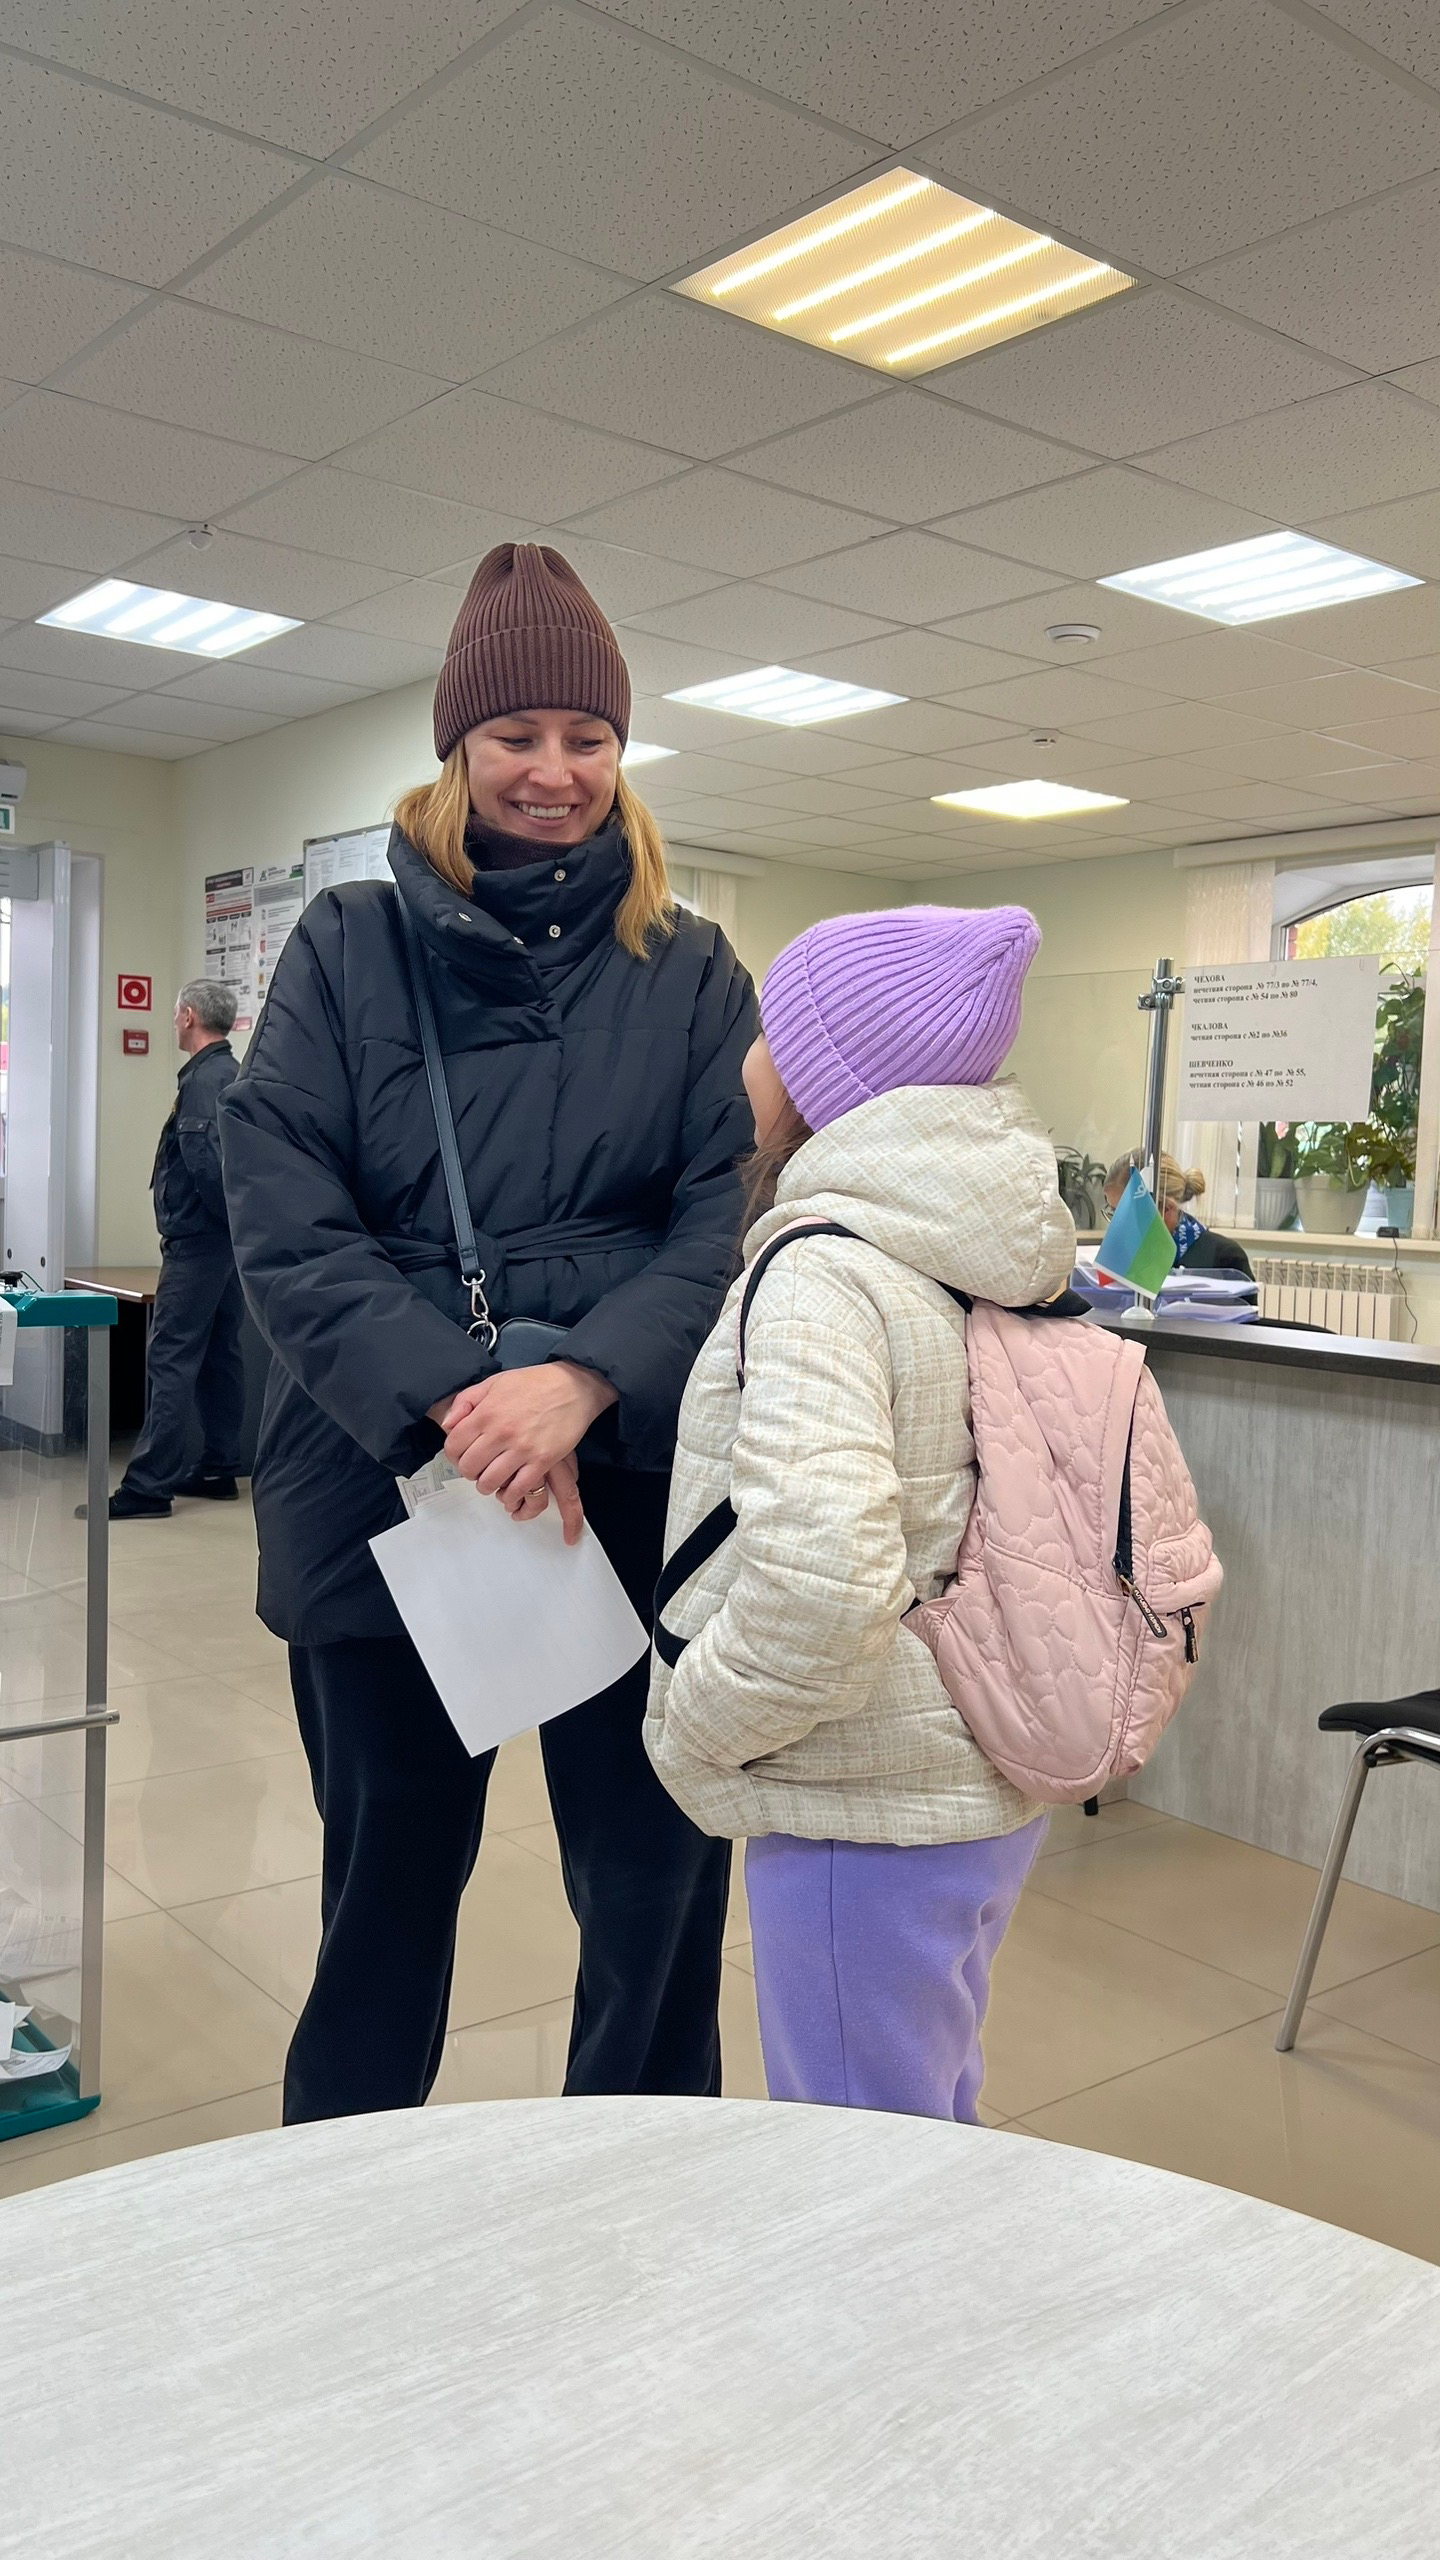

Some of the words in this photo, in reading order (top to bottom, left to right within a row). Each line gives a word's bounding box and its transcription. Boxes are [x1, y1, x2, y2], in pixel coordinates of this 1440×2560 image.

[1194, 975, 1225, 983] ЧЕХОВА
[1193, 986, 1223, 994] нечетная
[1225, 985, 1253, 993] сторона
[1217, 996, 1244, 1004] сторона
[1191, 1023, 1228, 1031] ЧКАЛОВА
[1214, 1033, 1241, 1042] сторона
[1189, 1060, 1234, 1068] ШЕВЧЕНКО
[1221, 1071, 1248, 1079] сторона
[1213, 1081, 1240, 1089] сторона
[1285, 1079, 1293, 1087] 52
